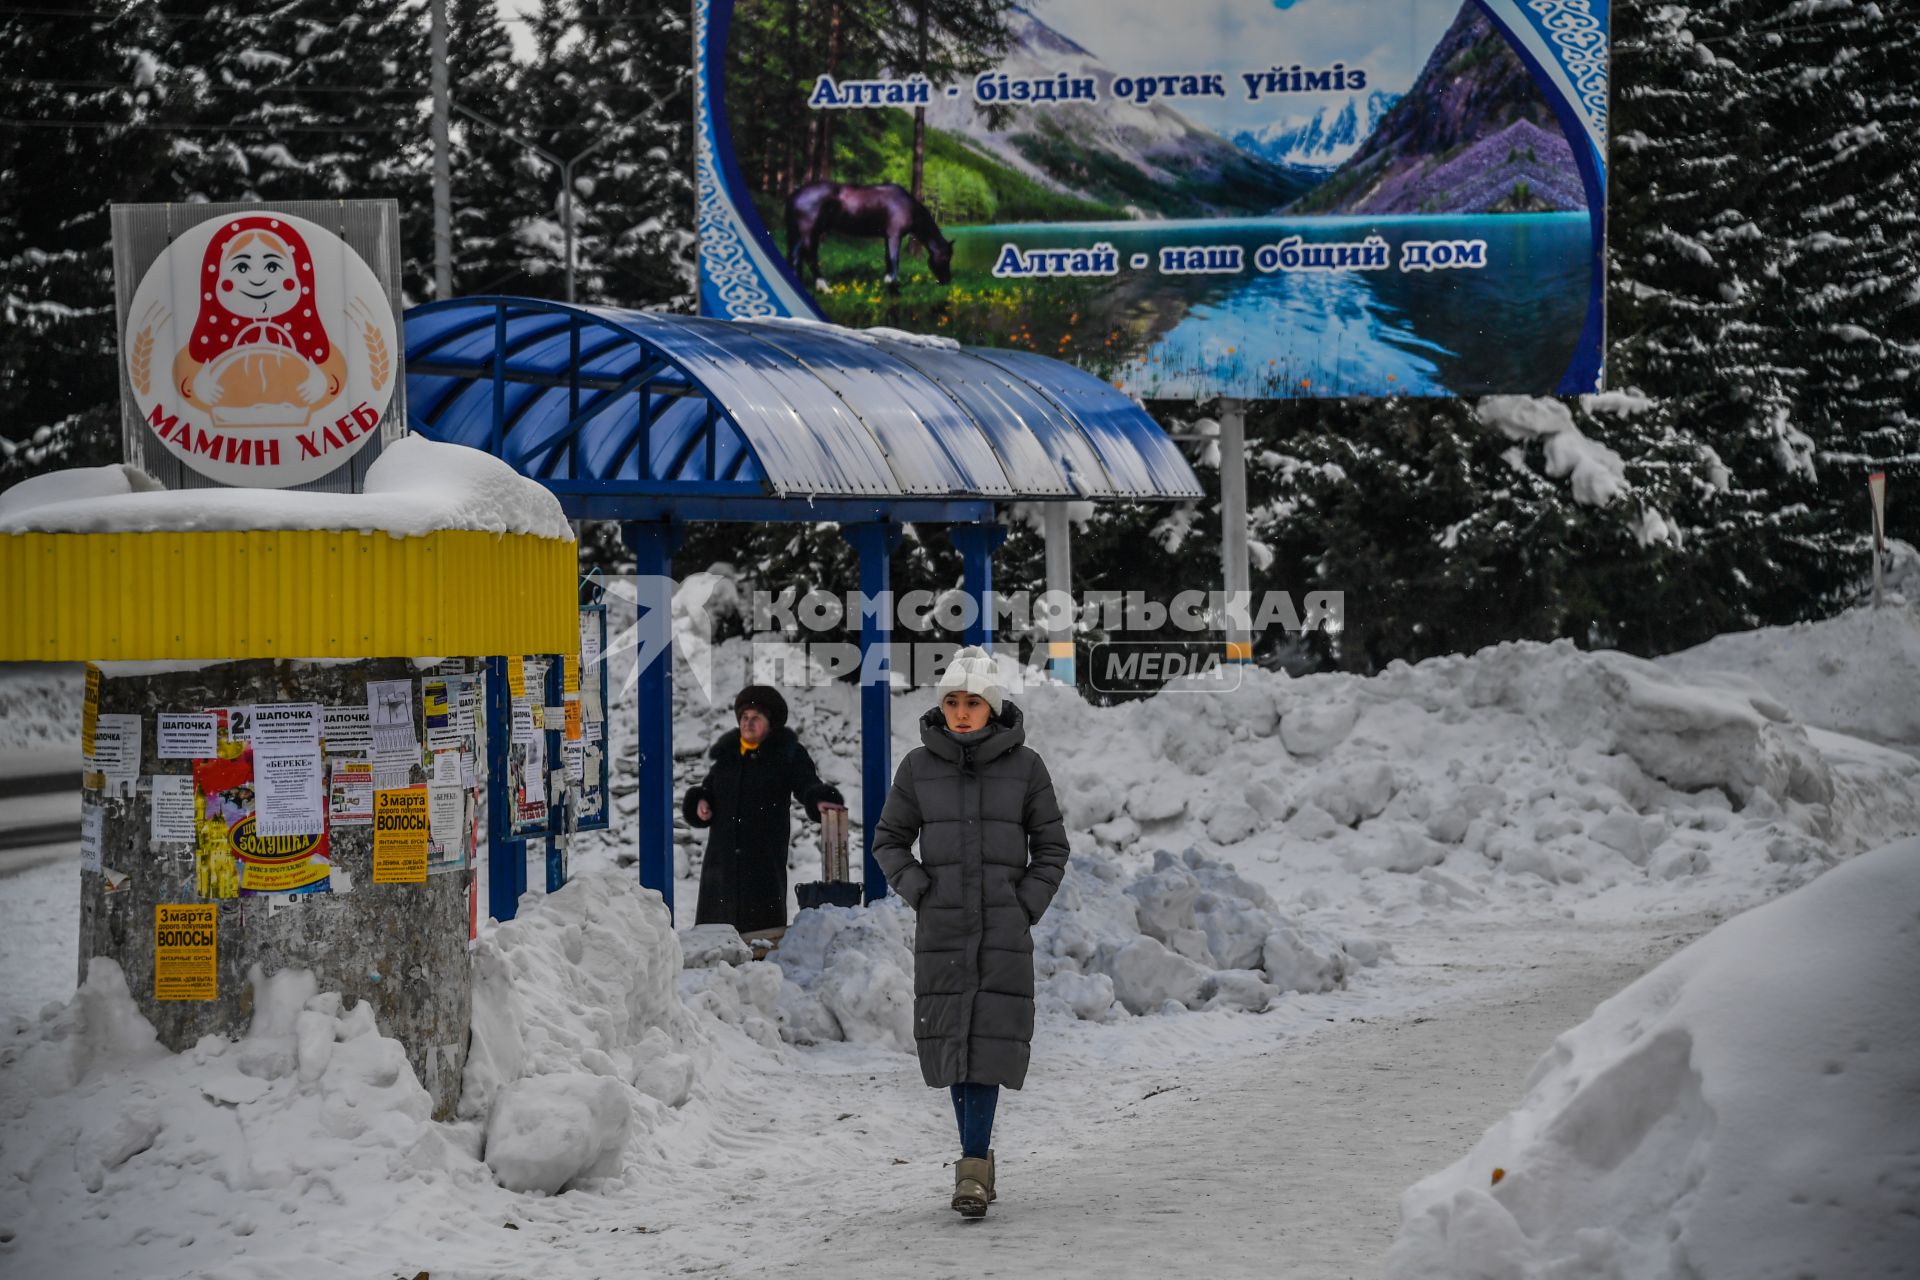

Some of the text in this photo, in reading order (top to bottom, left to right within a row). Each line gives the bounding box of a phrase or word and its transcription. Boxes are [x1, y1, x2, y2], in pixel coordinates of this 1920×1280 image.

[811, 75, 930, 105] Алтай
[975, 72, 1097, 102] біздің
[1113, 74, 1226, 102] ортақ
[1242, 63, 1367, 100] үйіміз
[995, 246, 1116, 274] Алтай
[1162, 249, 1242, 271] наш
[1257, 238, 1387, 270] общий
[1403, 244, 1483, 268] дом
[146, 401, 379, 466] МАМИН ХЛЕБ
[256, 711, 313, 720] ШАПОЧКА
[162, 721, 212, 730] ШАПОЧКА
[95, 733, 120, 741] АПОЧКА
[266, 760, 312, 768] «БЕРЕКЕ»
[380, 793, 426, 809] 3 марта
[378, 807, 399, 815] дорого
[377, 815, 426, 831] ВОЛОСЫ
[160, 909, 213, 924] 3 марта
[158, 931, 214, 947] ВОЛОСЫ
